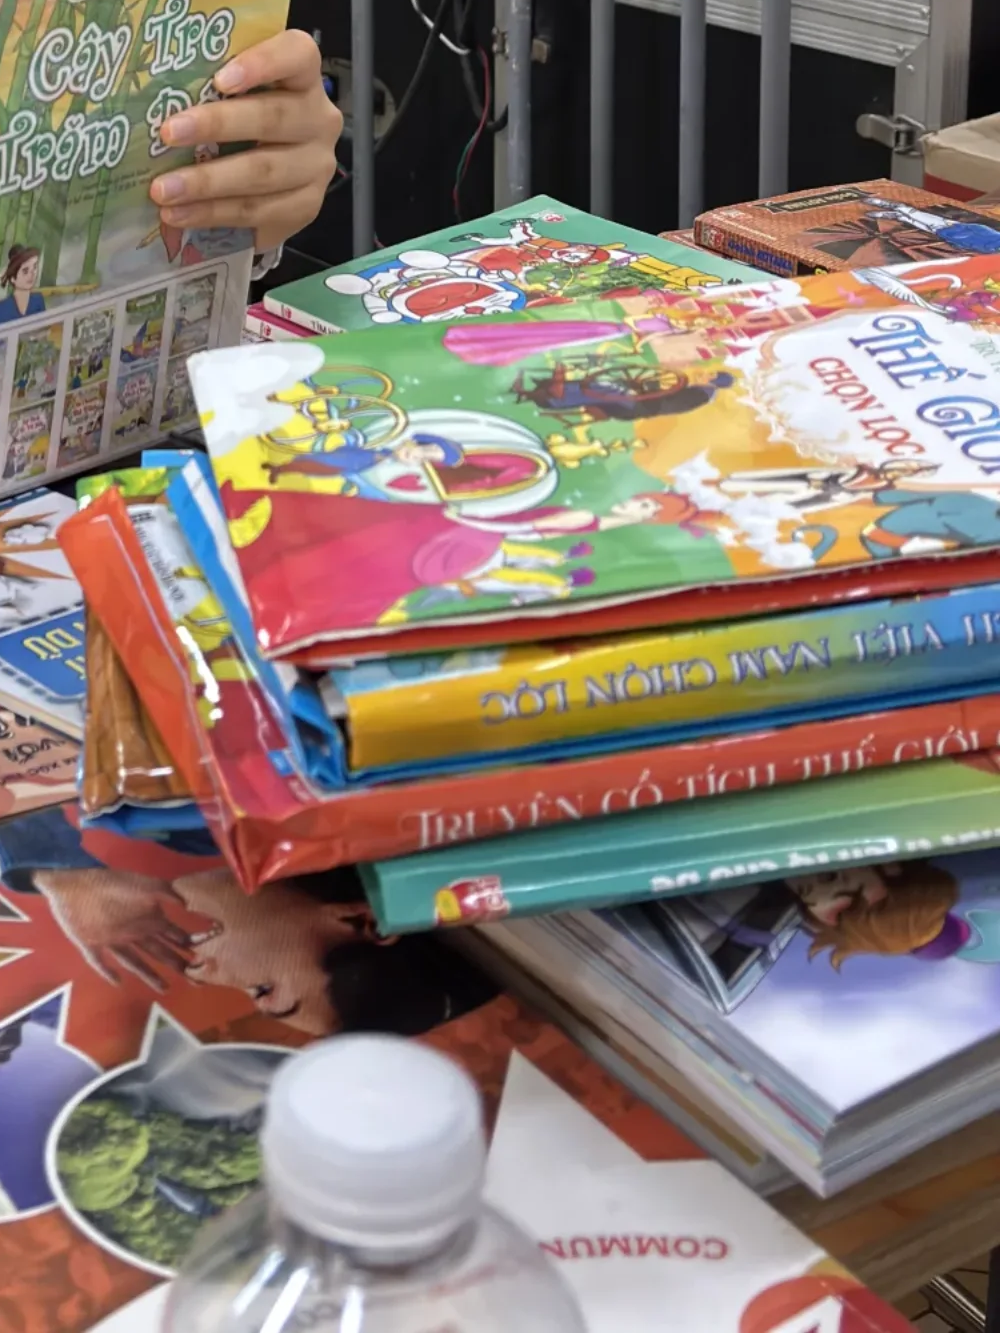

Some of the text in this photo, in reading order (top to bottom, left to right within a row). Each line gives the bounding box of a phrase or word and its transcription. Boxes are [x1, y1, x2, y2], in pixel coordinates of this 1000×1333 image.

[29, 22, 131, 101] Cây
[848, 314, 986, 389] THẾ
[808, 356, 926, 457] CHỌN LỌC
[725, 636, 831, 687] NAM
[851, 619, 945, 663] VIỆT
[479, 678, 567, 727] LỌC
[583, 657, 717, 708] CHỌN
